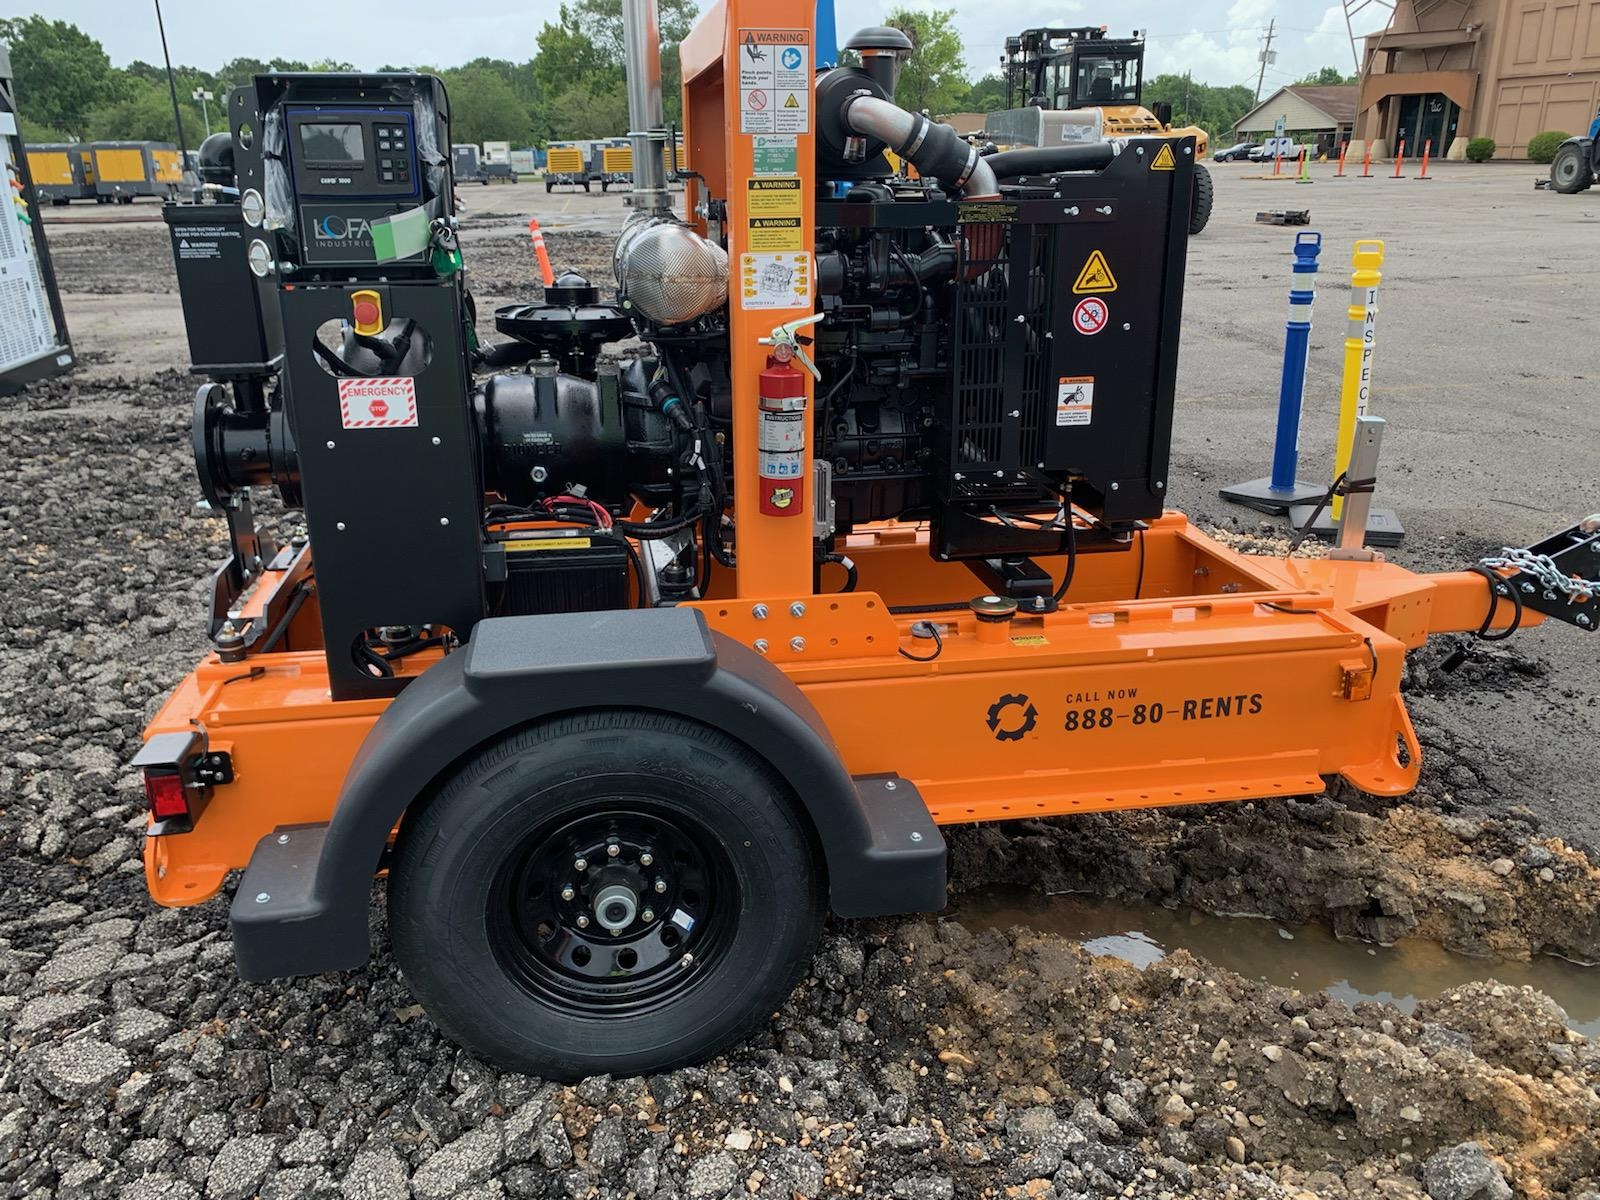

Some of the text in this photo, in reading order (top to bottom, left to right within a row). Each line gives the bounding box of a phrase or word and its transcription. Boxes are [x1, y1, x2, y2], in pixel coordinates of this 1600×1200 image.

[757, 33, 804, 42] WARNING
[313, 215, 373, 239] LOFA
[1358, 290, 1376, 416] INSPECT
[347, 386, 407, 397] EMERGENCY
[1066, 688, 1138, 704] CALL NOW
[1064, 693, 1263, 731] 888-80-RENTS
